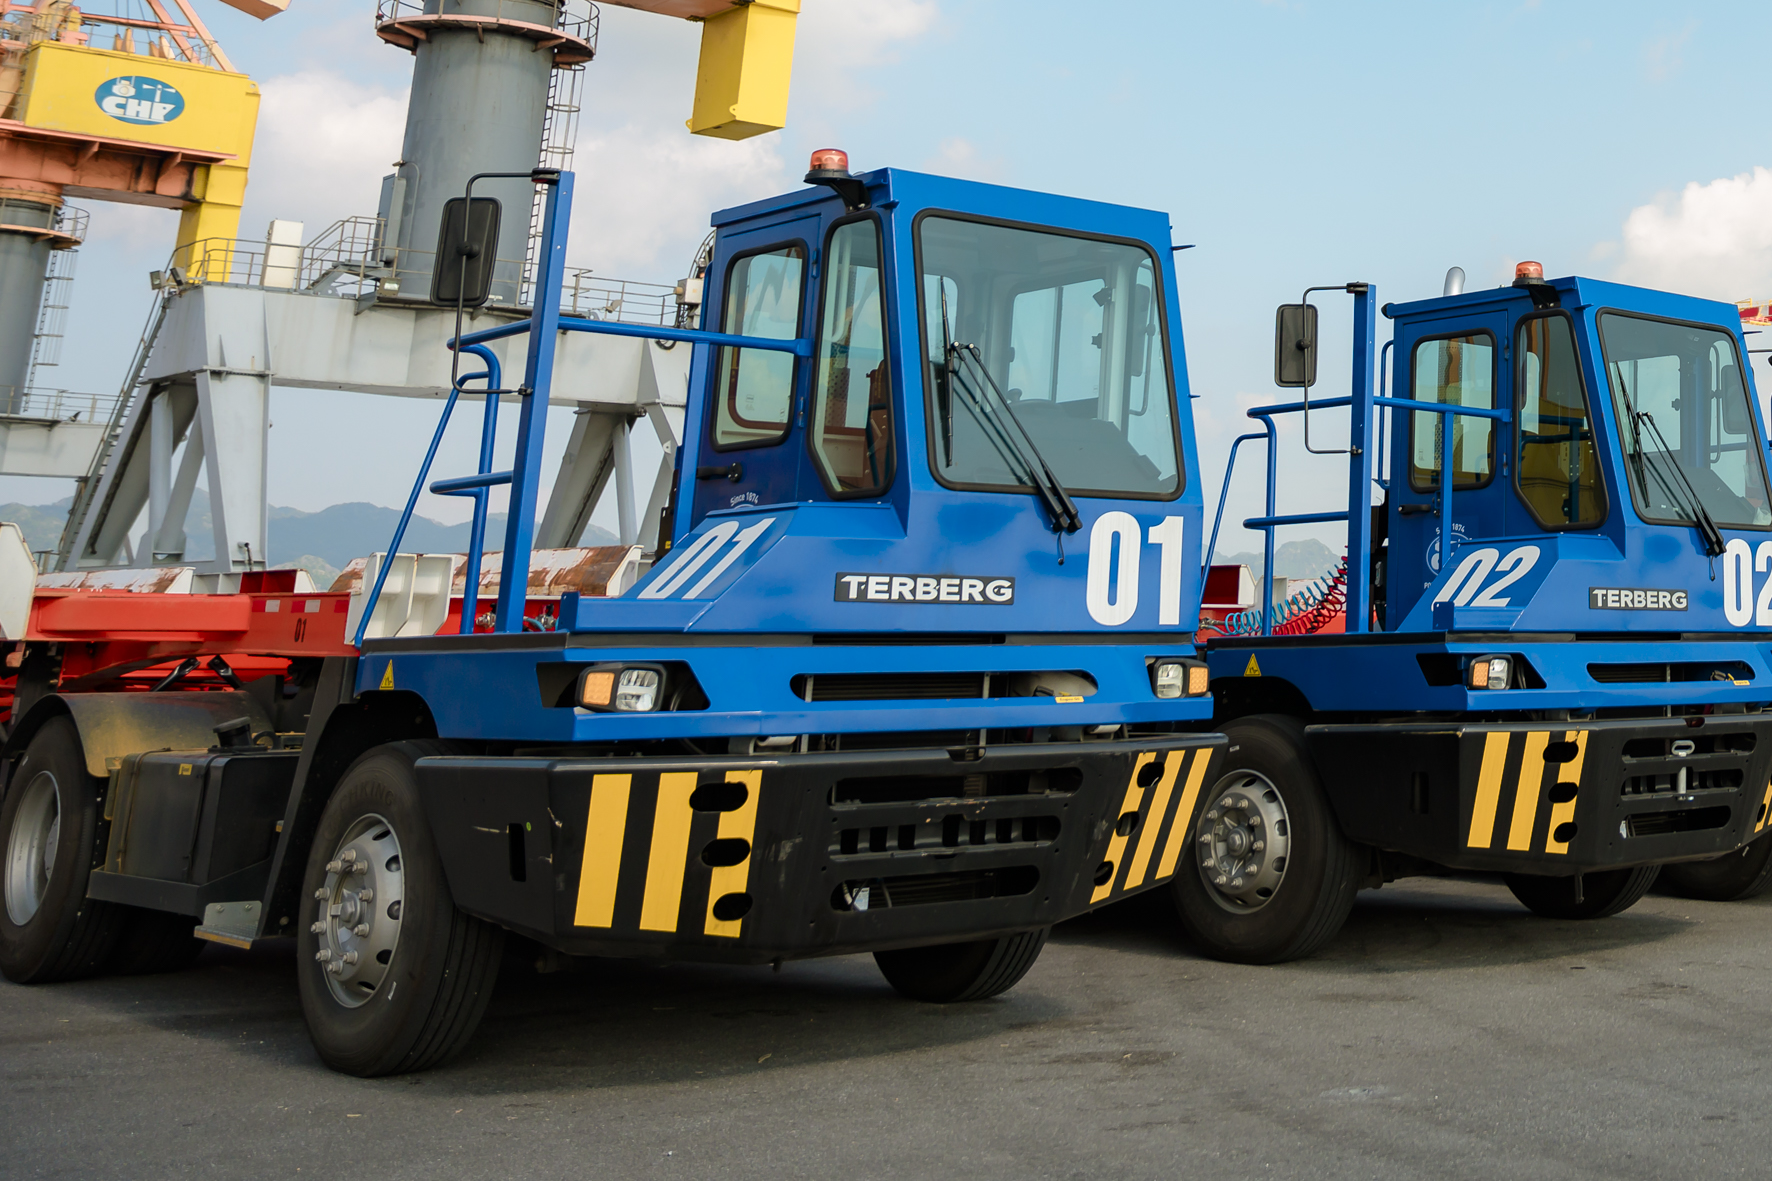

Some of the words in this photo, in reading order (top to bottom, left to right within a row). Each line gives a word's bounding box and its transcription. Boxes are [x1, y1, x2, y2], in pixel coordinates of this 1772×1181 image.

[730, 493, 745, 507] Since
[746, 491, 760, 505] 1874
[1452, 523, 1465, 533] 1874
[637, 517, 777, 600] 01
[1086, 511, 1185, 626] 01
[840, 574, 1014, 603] TERBERG
[1431, 545, 1541, 612] 02
[1592, 588, 1688, 609] TERBERG
[294, 617, 307, 643] 01
